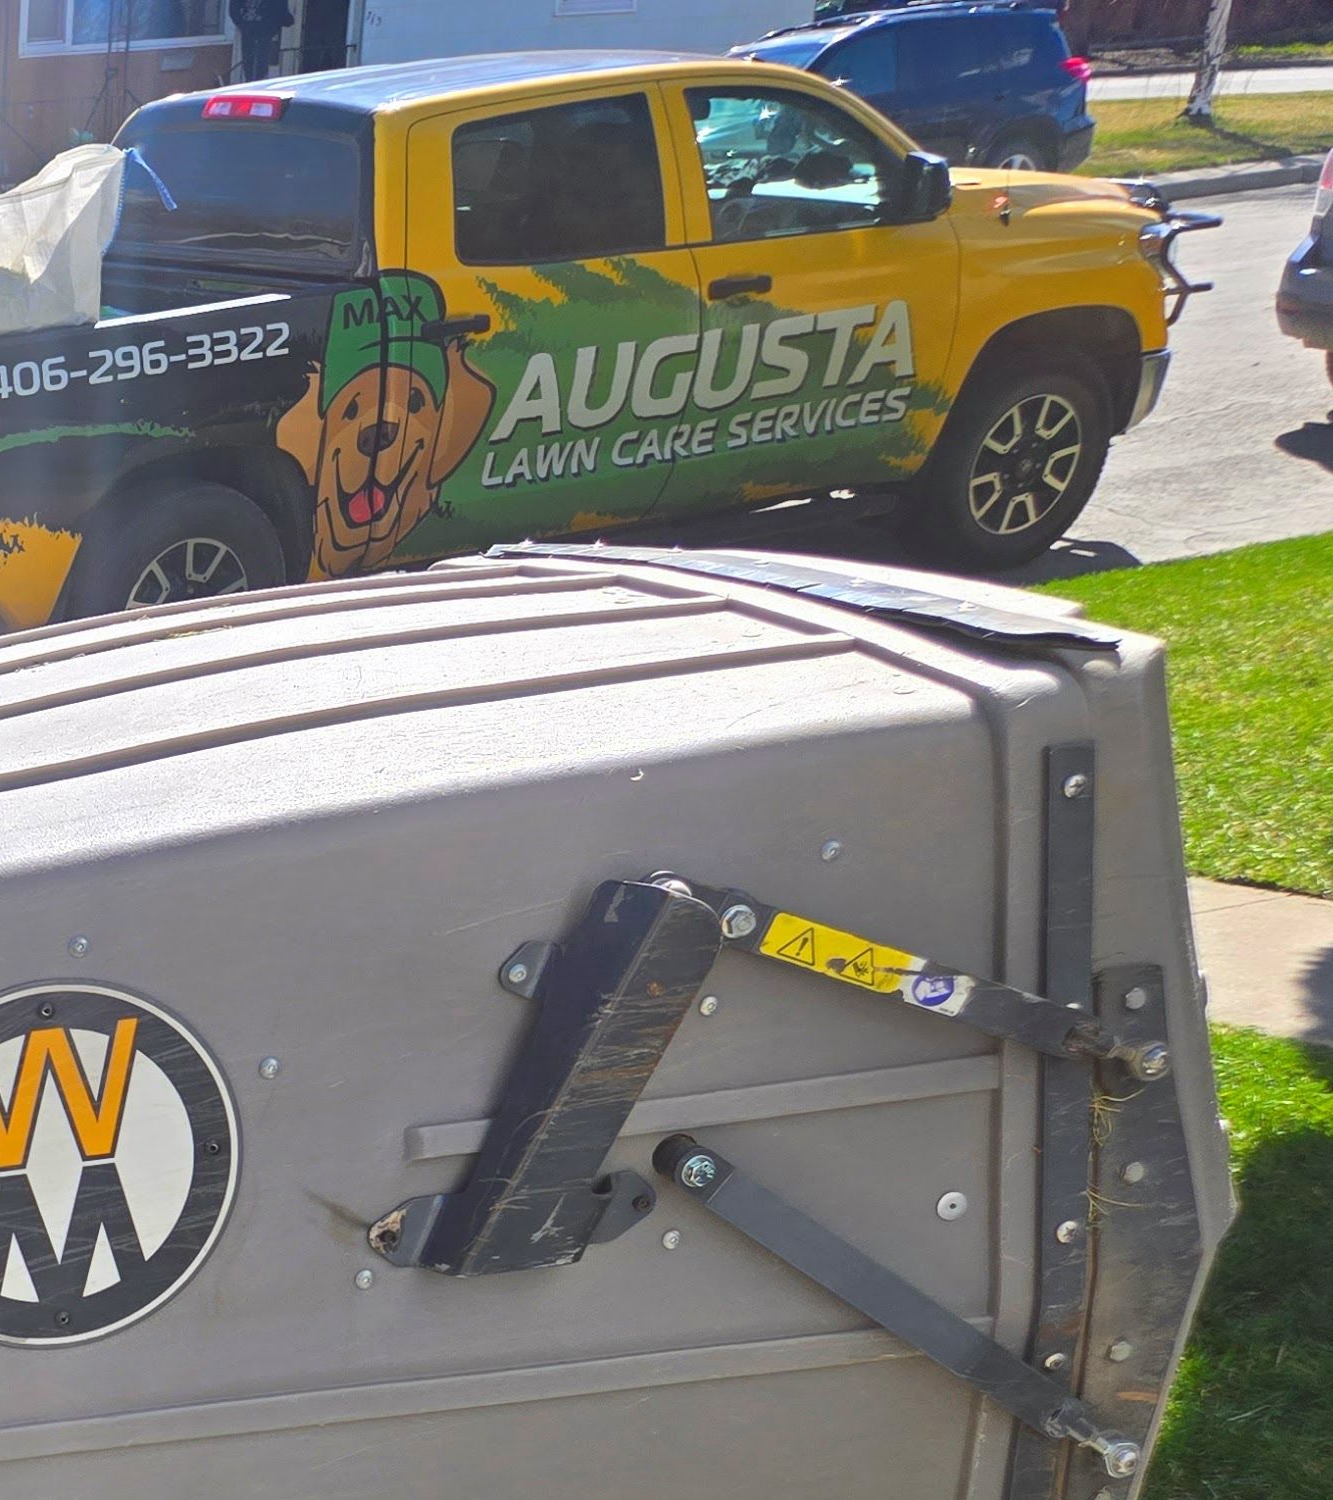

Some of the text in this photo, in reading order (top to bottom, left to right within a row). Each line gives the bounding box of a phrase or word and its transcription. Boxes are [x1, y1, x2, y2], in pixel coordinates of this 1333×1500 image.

[342, 295, 428, 331] MAX
[489, 299, 916, 444] AUGUSTA
[480, 386, 912, 488] LAWN CARE SERVICES
